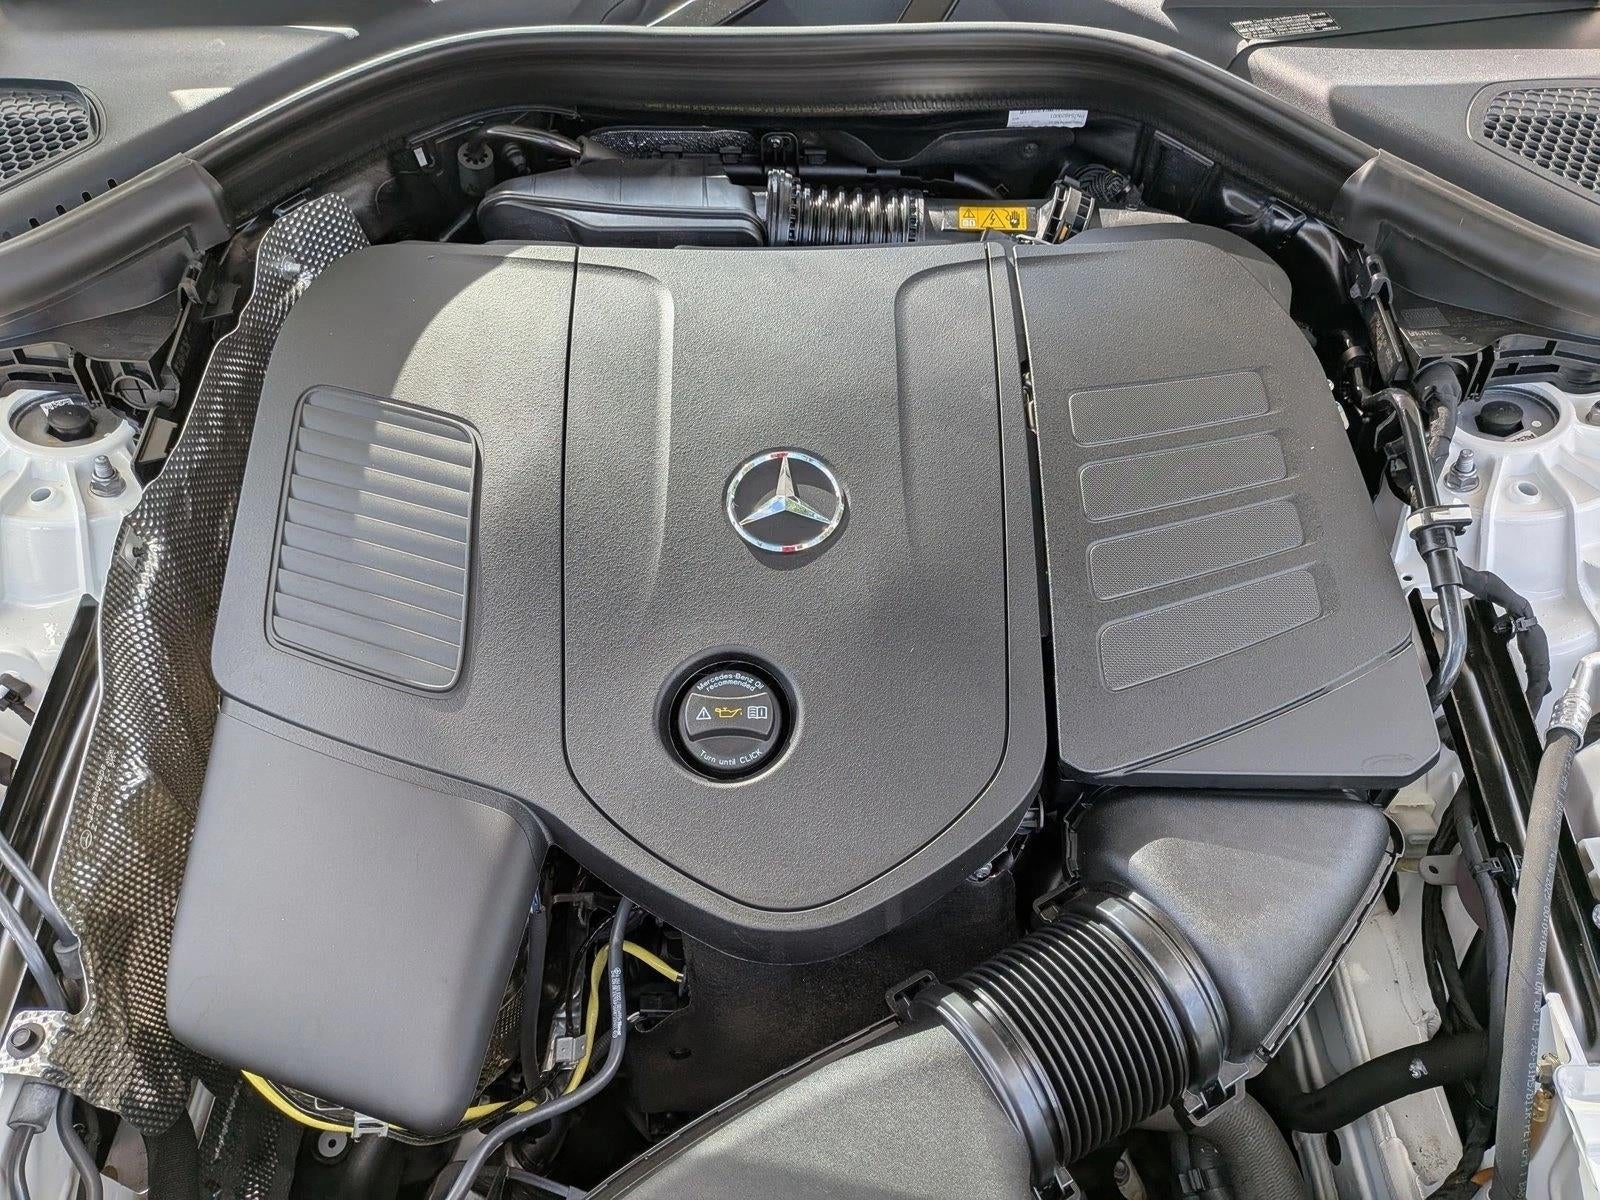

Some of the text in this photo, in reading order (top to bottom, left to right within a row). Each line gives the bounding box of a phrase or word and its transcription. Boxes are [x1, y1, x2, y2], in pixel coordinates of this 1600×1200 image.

[697, 673, 764, 690] Mercedes-Benz Oil
[706, 679, 756, 692] recommended
[700, 749, 716, 763] Turn
[740, 748, 762, 764] CLICK
